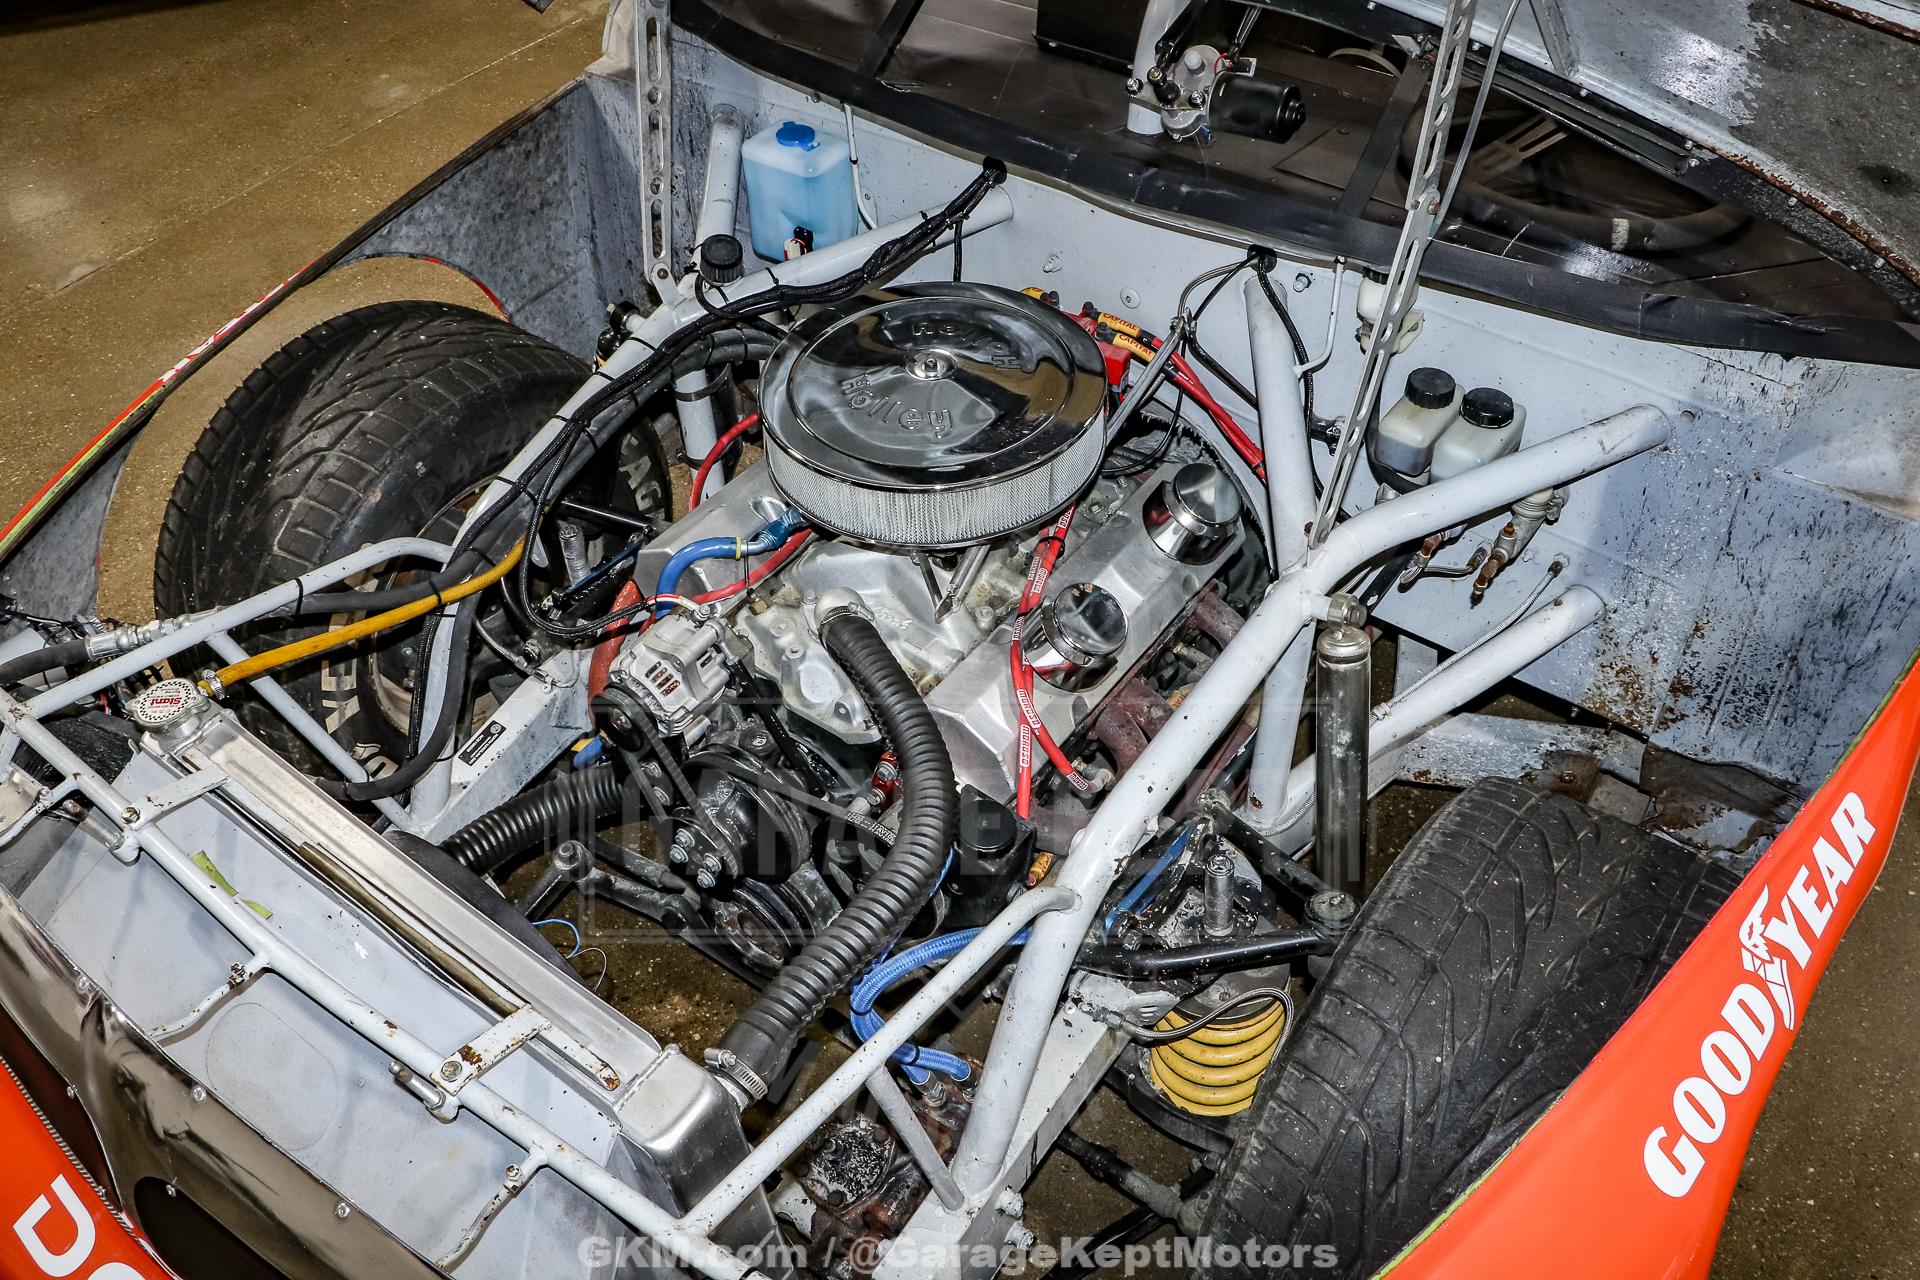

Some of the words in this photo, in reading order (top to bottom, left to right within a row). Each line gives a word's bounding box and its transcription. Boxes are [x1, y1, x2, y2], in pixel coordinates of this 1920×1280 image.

[1103, 313, 1138, 330] CAPITAL
[1119, 334, 1153, 356] CAPITAL
[839, 374, 953, 440] Holley
[148, 697, 183, 706] Stant
[1018, 690, 1041, 727] MOROSO
[1021, 725, 1030, 768] MOROSO
[1643, 791, 1876, 1198] GOODYEAR
